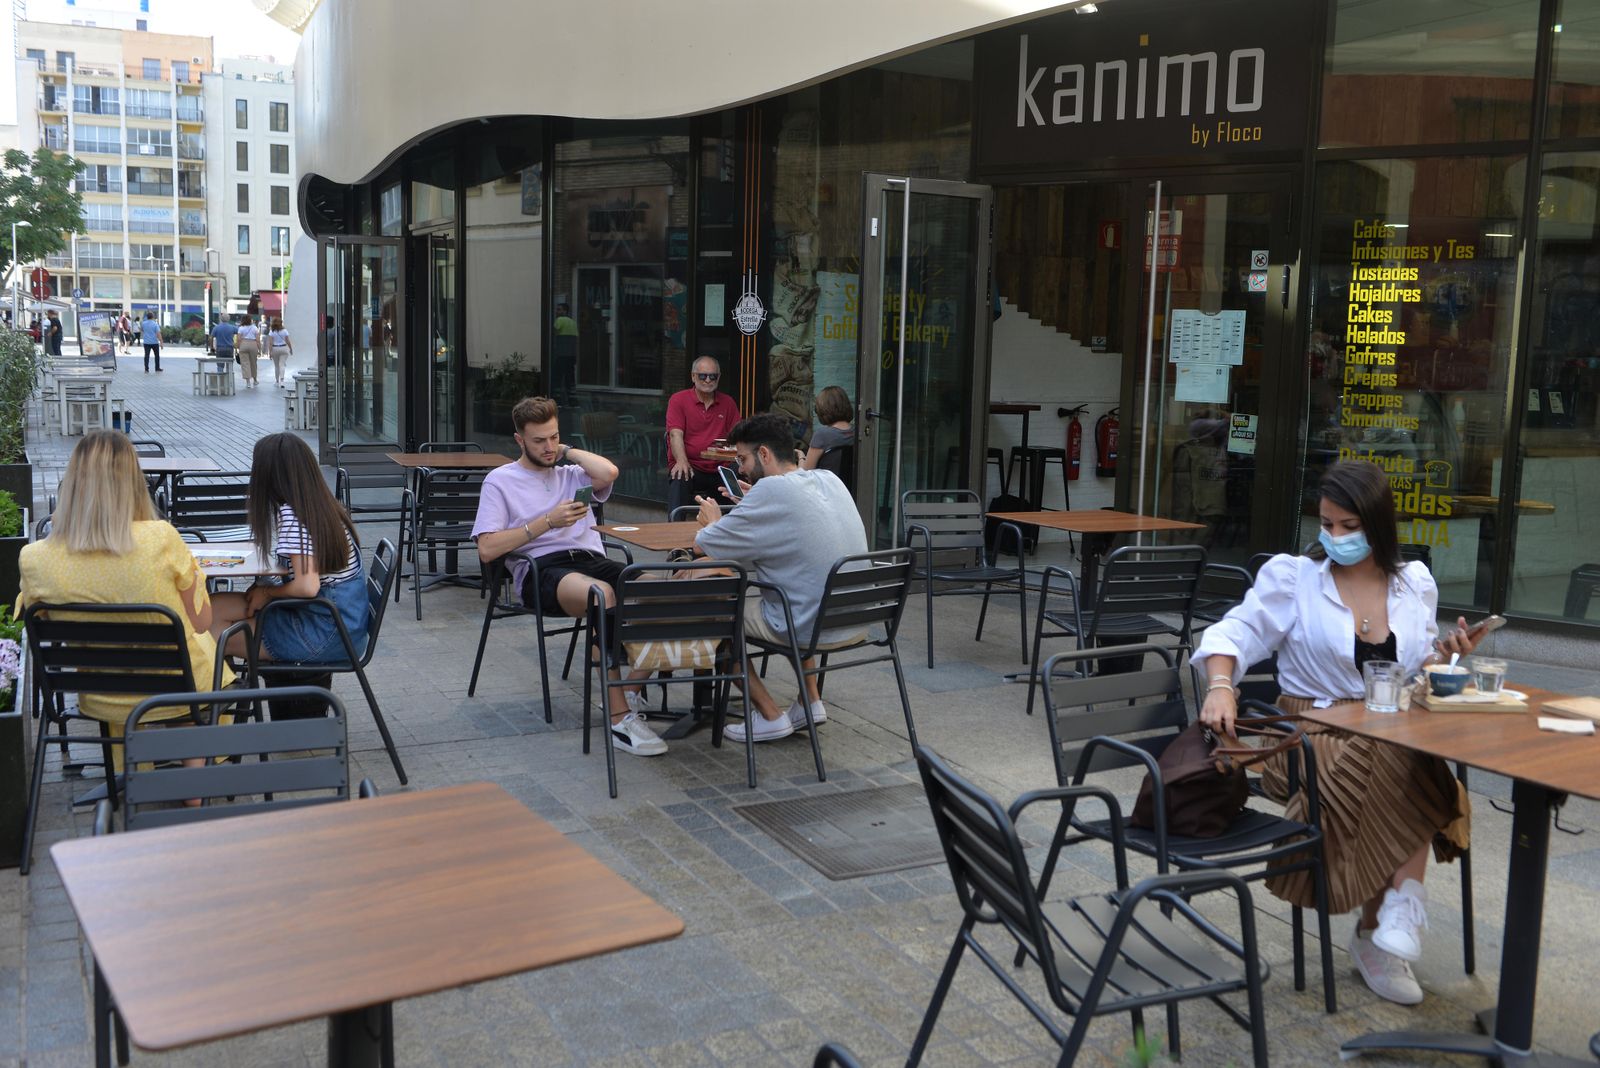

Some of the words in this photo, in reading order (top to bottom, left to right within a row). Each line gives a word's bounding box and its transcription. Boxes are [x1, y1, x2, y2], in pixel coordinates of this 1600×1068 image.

[1017, 34, 1265, 127] kanimo
[1191, 123, 1209, 148] by
[1217, 121, 1262, 143] Floco
[1147, 237, 1178, 246] Arma
[1352, 240, 1429, 260] Infusiones
[1433, 245, 1442, 263] y
[1447, 239, 1475, 259] Tes
[1351, 261, 1419, 281] Tostadas
[1349, 282, 1421, 306] Hojaldres
[1348, 303, 1393, 323] Cakes
[1346, 324, 1406, 345] Helados
[1345, 345, 1396, 365] Gofres
[1344, 366, 1398, 390] Crepes
[1342, 387, 1403, 411] Frappes
[1341, 407, 1419, 429] Smoothies
